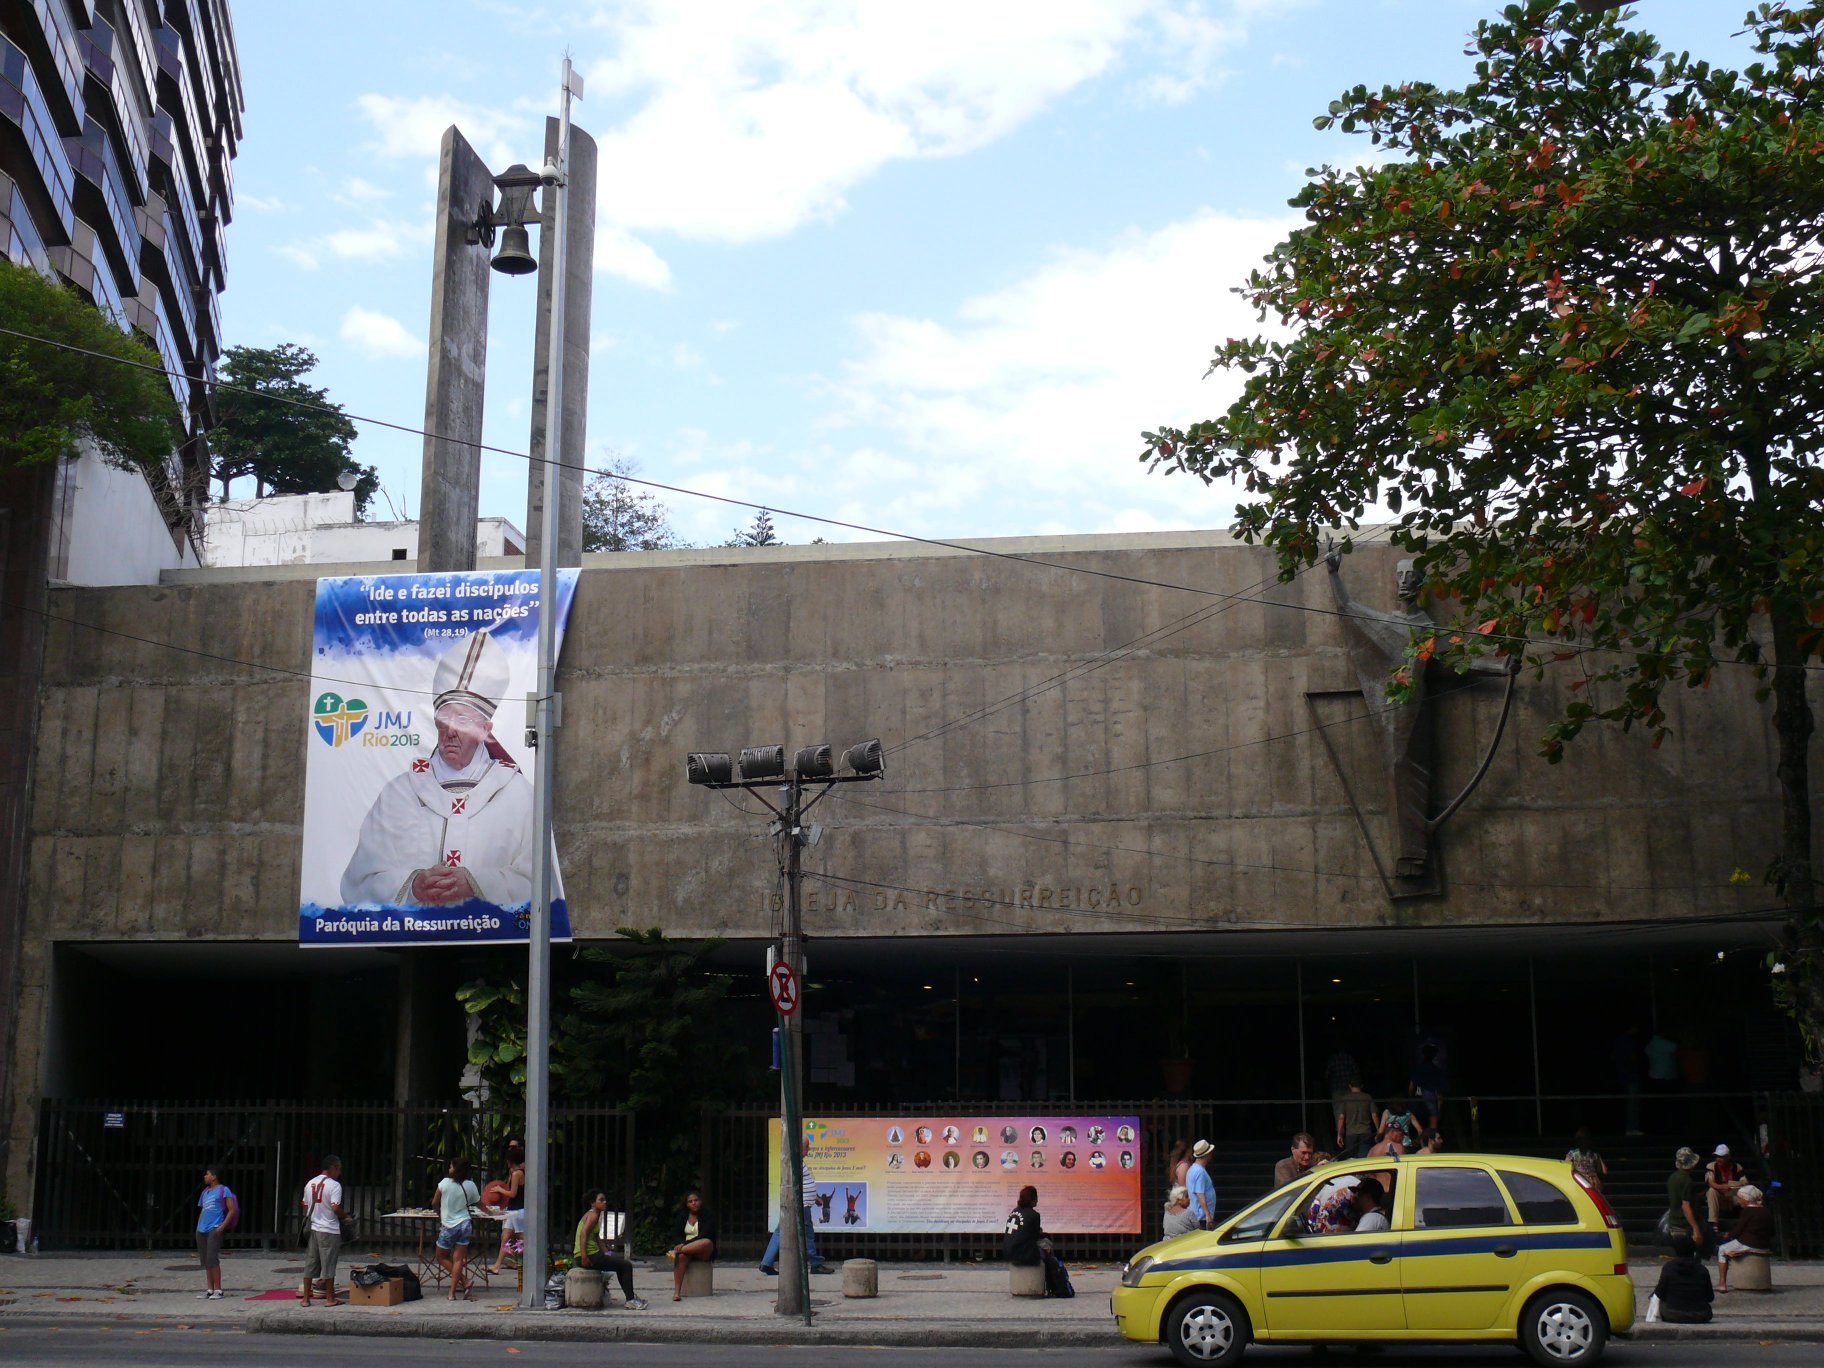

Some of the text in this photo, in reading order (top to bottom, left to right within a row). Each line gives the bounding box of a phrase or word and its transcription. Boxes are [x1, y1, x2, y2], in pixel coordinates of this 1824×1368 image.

[398, 589, 406, 600] e
[411, 583, 451, 599] fazei
[455, 580, 539, 600] discípulos
[355, 610, 398, 625] entre
[401, 607, 447, 623] todas
[451, 610, 469, 622] as
[424, 627, 469, 638] (Mt 28,19)
[374, 711, 412, 730] JMJ
[759, 882, 1142, 913] IGEJA DA RESSURREIÇÃO
[315, 917, 379, 936] Paróquia
[383, 917, 400, 931] da
[404, 915, 500, 934] Ressurreição
